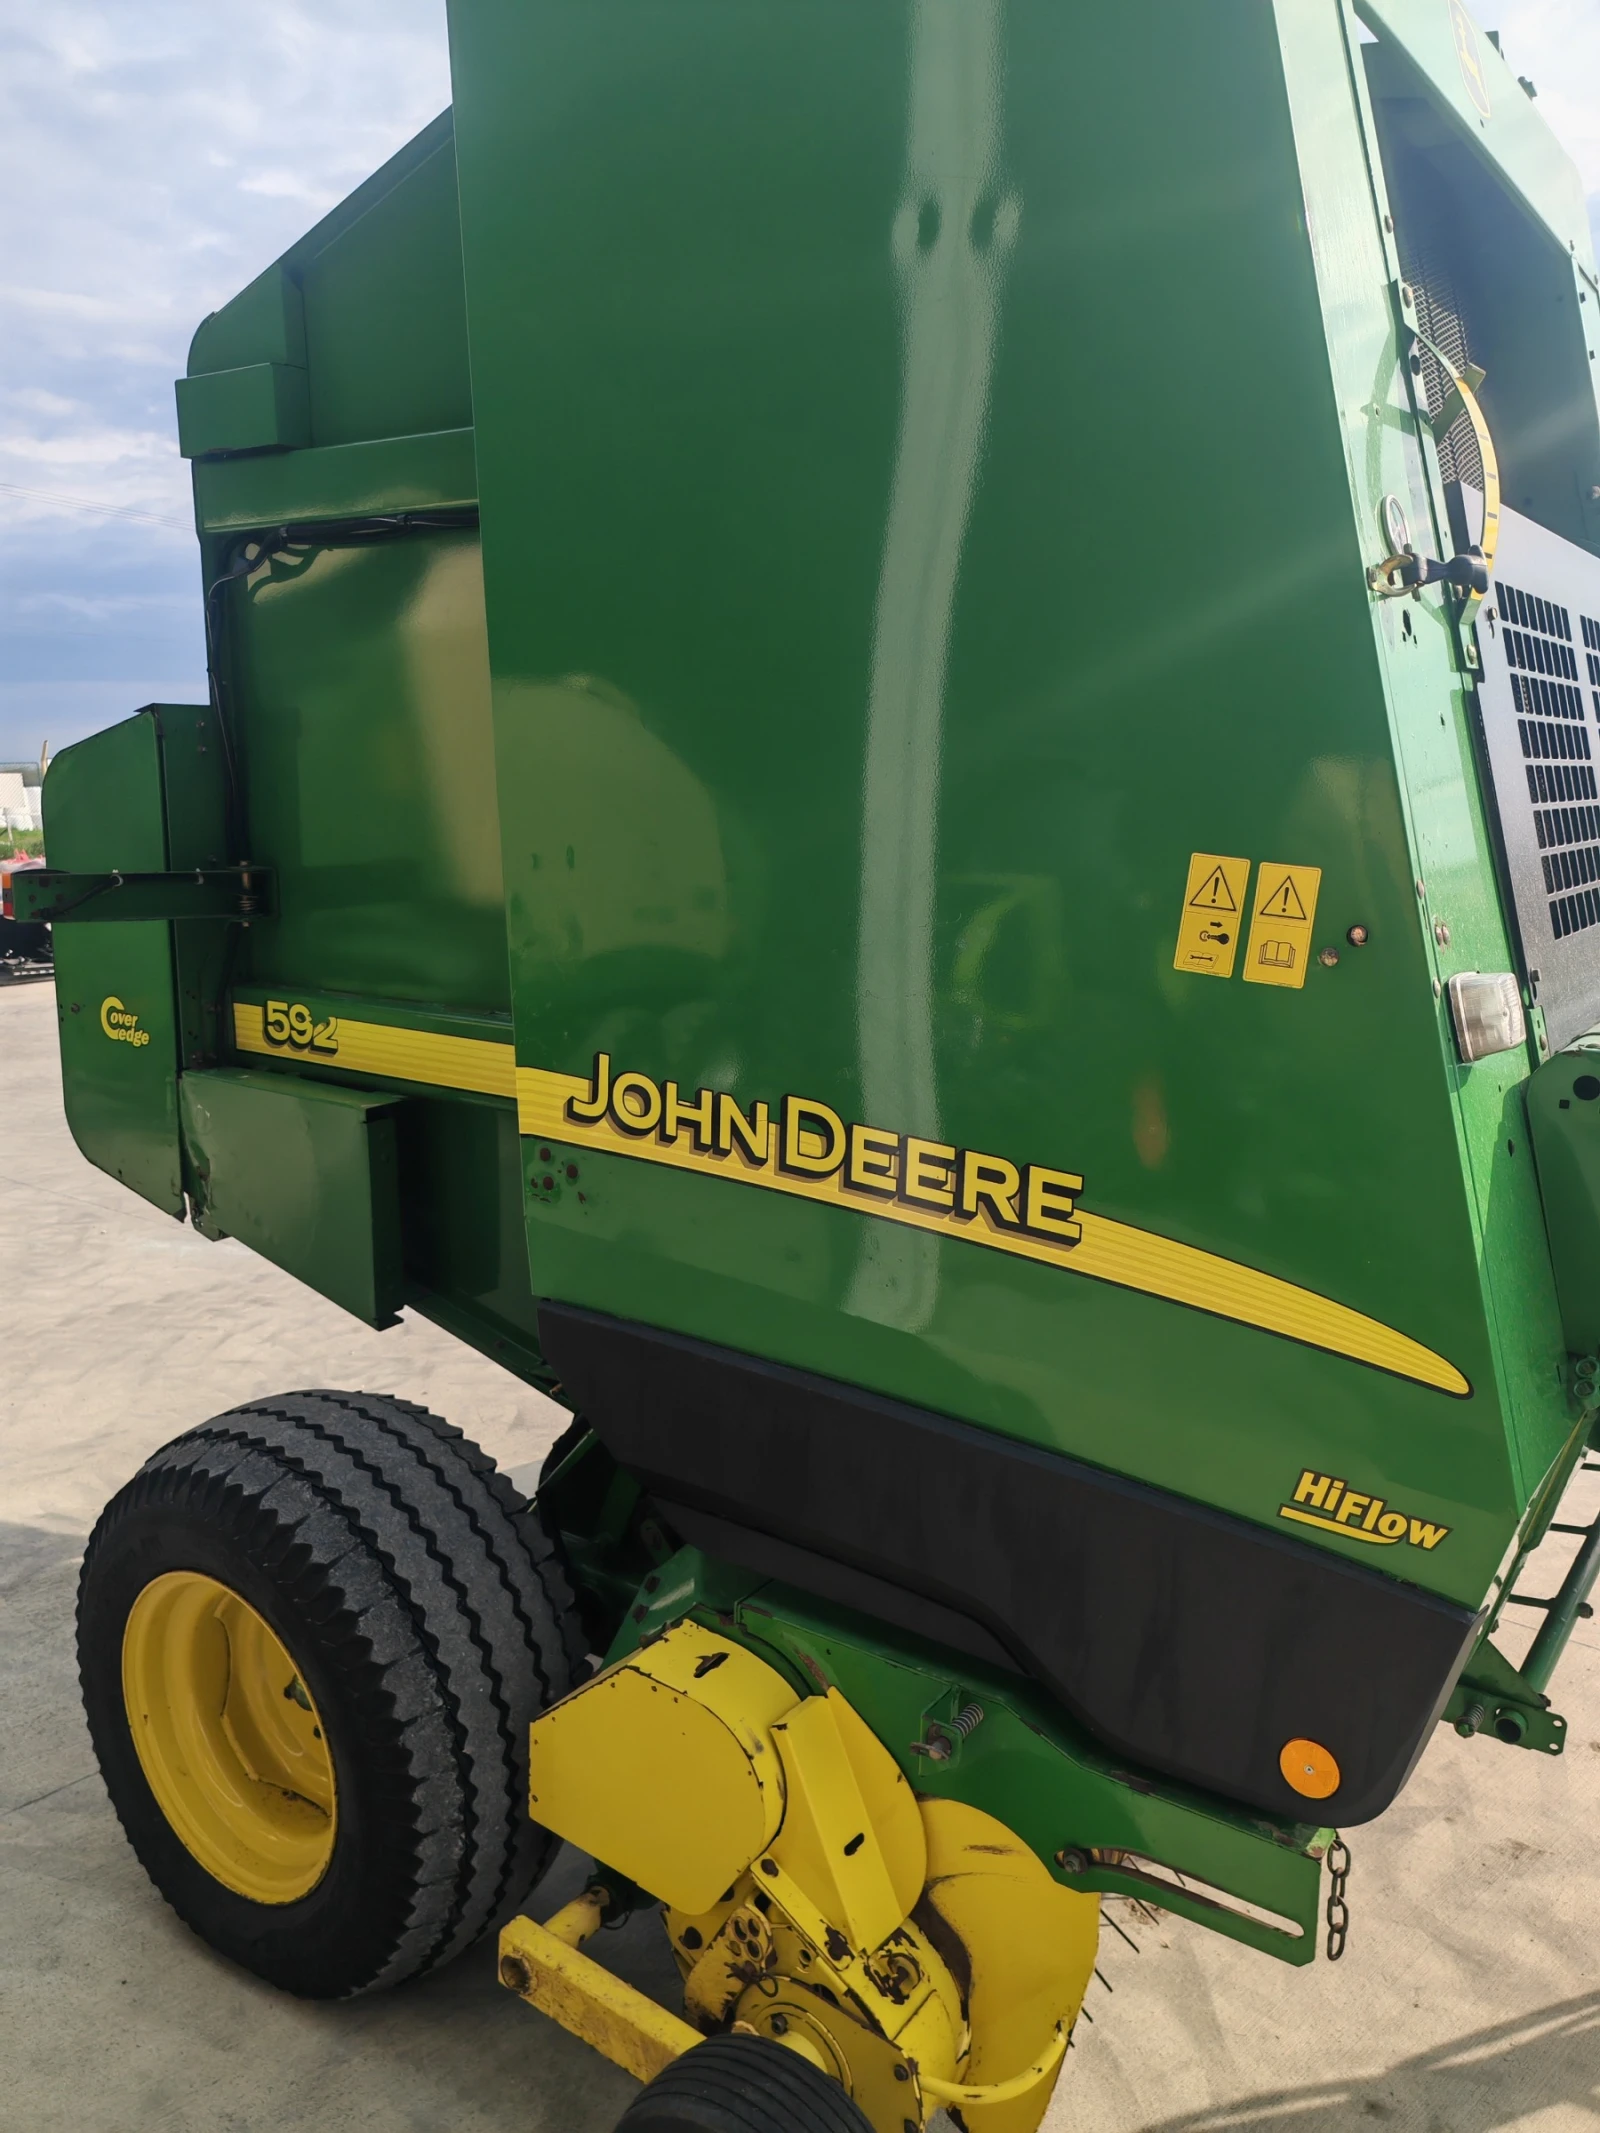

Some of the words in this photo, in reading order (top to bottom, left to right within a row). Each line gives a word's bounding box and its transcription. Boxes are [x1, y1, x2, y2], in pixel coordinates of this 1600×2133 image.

[101, 996, 138, 1039] Cover
[118, 1028, 149, 1047] edge
[264, 1000, 338, 1055] 592
[567, 1052, 769, 1167] JOHN
[777, 1095, 1084, 1248] DEERE
[1292, 1471, 1449, 1550] HiFlow
